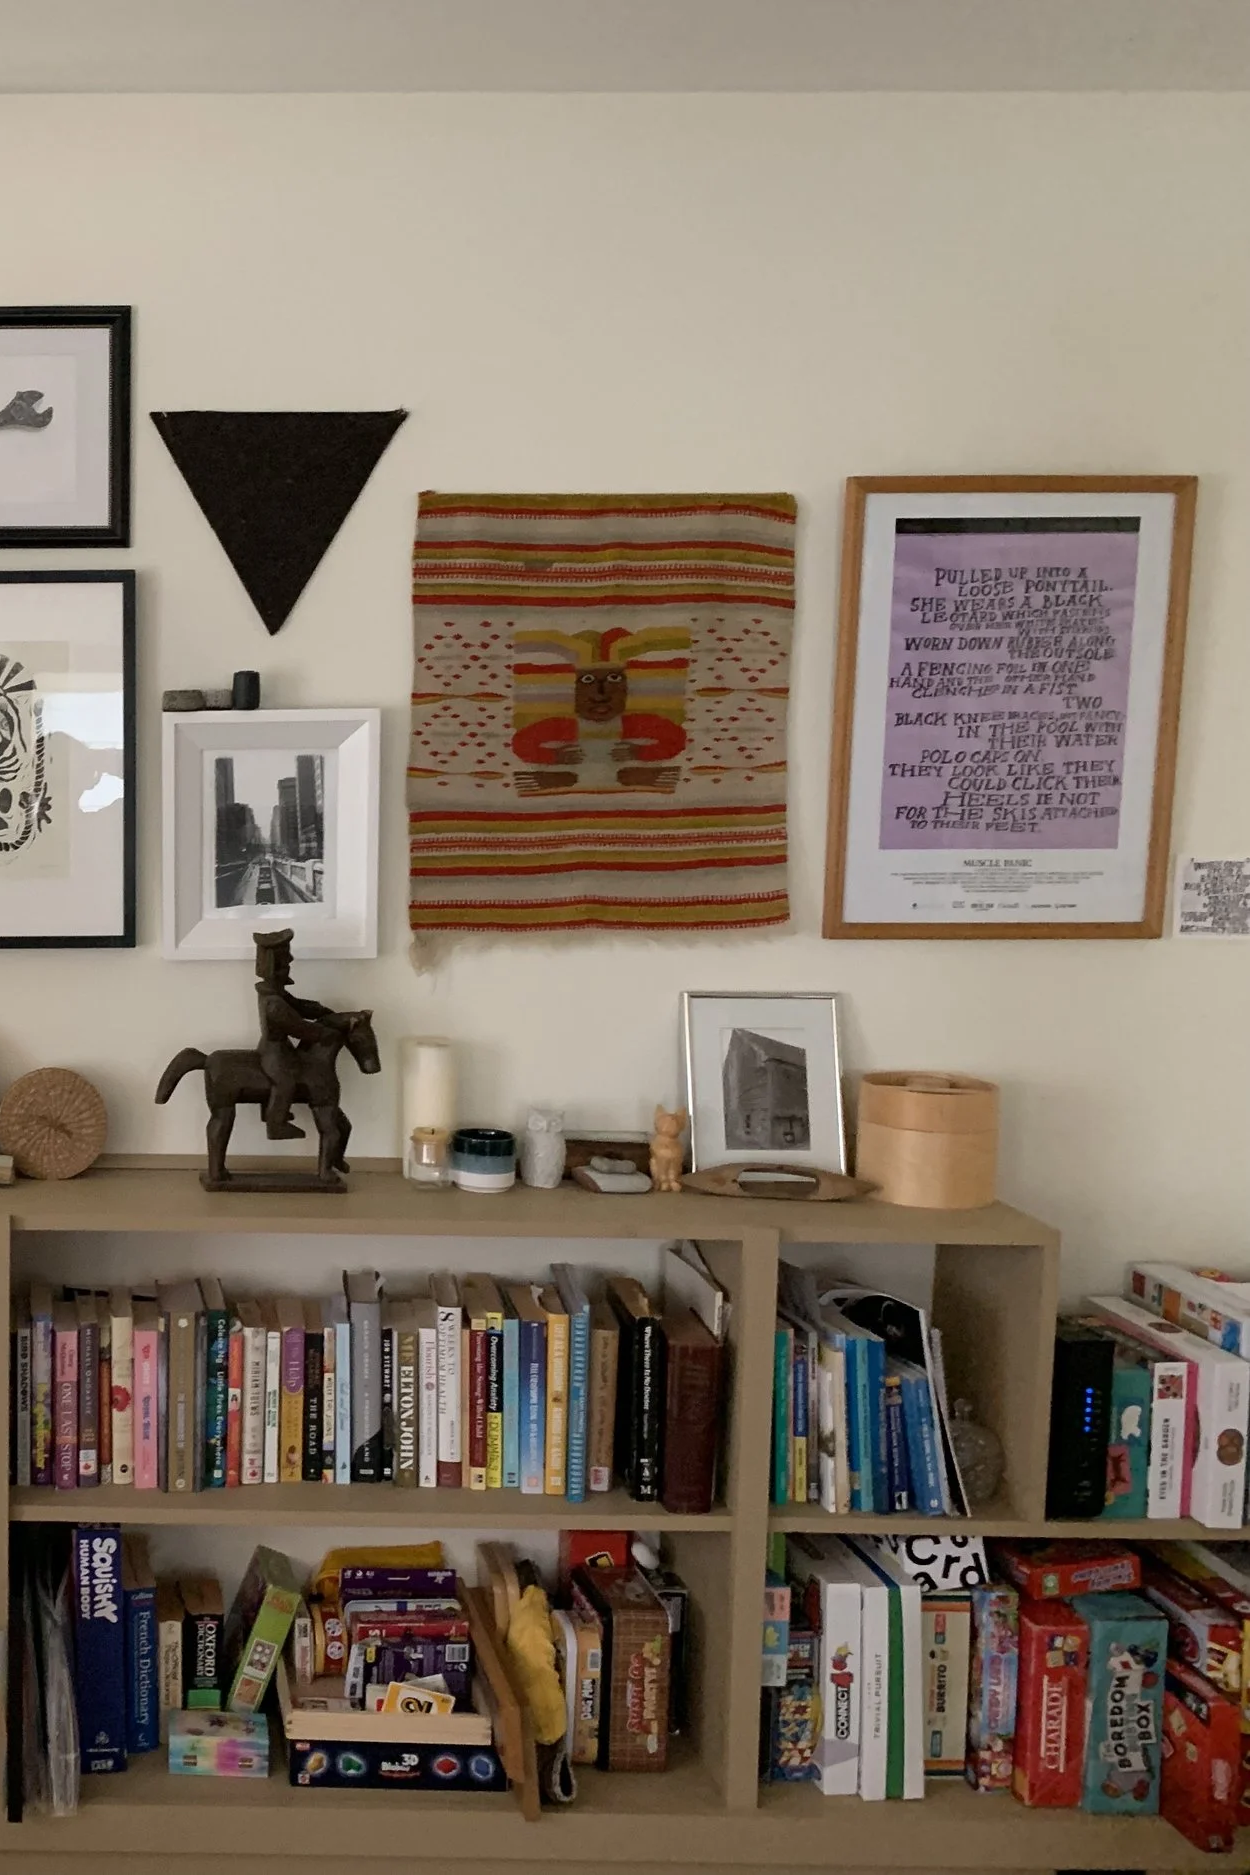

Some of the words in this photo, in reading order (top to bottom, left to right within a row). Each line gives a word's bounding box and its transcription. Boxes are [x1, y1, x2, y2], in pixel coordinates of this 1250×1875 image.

[935, 567, 1004, 587] PULLED
[1008, 567, 1028, 581] UP
[1036, 567, 1071, 579] INTO
[1077, 567, 1088, 579] A
[957, 580, 1014, 598] LOOSE
[1024, 579, 1114, 596] PONYTAIL.
[910, 597, 946, 613] SHE
[954, 596, 1015, 613] WEARS
[1021, 596, 1032, 610] A
[1042, 594, 1102, 610] BLACK
[920, 609, 998, 624] LEOTARD
[1001, 608, 1050, 622] WHICH
[904, 637, 954, 651] WORN
[957, 637, 1003, 650] DOWN
[1069, 635, 1116, 648] ALONG
[1008, 649, 1040, 660] THE
[1042, 648, 1118, 661] OUTSOLE
[900, 662, 913, 677] A
[917, 661, 993, 677] FENCING
[1031, 661, 1047, 674] IN
[1052, 660, 1090, 674] ONE
[889, 675, 935, 690] HAND
[1053, 672, 1096, 683] HAND
[1001, 684, 1019, 695] IN
[1025, 683, 1036, 695] A
[1039, 682, 1078, 697] FIST
[1062, 696, 1103, 710] TWO
[894, 712, 948, 727] BLACK
[953, 711, 1004, 726] KNEE
[957, 725, 980, 739] IN
[989, 722, 1030, 738] THE
[1037, 721, 1078, 735] POOL
[1084, 722, 1124, 734] WITH
[988, 735, 1047, 750] THEIR
[1054, 734, 1119, 748] WATER
[920, 749, 967, 764] POLO
[888, 763, 944, 778] THEY
[952, 764, 999, 777] LOOK
[1006, 763, 1054, 776] LIKE
[1062, 759, 1116, 775] THEY
[947, 776, 1007, 791] COULD
[1011, 776, 1070, 791] CLICK
[1073, 774, 1123, 788] THEIR
[941, 791, 1030, 808] HEELS
[1036, 793, 1053, 806] IF
[1058, 791, 1101, 806] NOT
[894, 806, 928, 820] FOR
[932, 805, 984, 821] THE
[992, 806, 1038, 823] SKIS
[910, 820, 929, 830] TO
[932, 820, 980, 831] THEIR
[963, 859, 1000, 868] MUSCLE
[216, 1318, 225, 1349] Celeste
[439, 1311, 455, 1322] 8
[448, 1362, 455, 1375] TO
[643, 1325, 652, 1349] Where
[20, 1335, 28, 1359] BIRD
[84, 1328, 93, 1366] MICHAEL
[215, 1350, 225, 1364] Ng
[402, 1335, 414, 1362] ME
[488, 1335, 498, 1381] Overcoming
[425, 1341, 436, 1379] Flourish
[475, 1362, 484, 1374] the
[643, 1349, 652, 1369] There
[216, 1371, 224, 1392] Little
[251, 1360, 260, 1389] MIRIAM
[285, 1361, 300, 1388] Help
[643, 1376, 651, 1387] No
[20, 1361, 28, 1412] SHADOWS
[61, 1382, 72, 1405] ONE
[400, 1365, 415, 1420] ELTON
[439, 1374, 447, 1415] HEALTH
[488, 1382, 498, 1411] Anxiety
[215, 1394, 224, 1414] Fires
[250, 1392, 260, 1416] TOEWS
[309, 1397, 317, 1420] THE
[61, 1411, 72, 1441] LAST
[475, 1420, 483, 1439] Child
[214, 1415, 224, 1465] Everywhere
[308, 1424, 317, 1455] ROAD
[399, 1421, 414, 1471] JOHN
[61, 1443, 72, 1471] STOP
[1160, 1452, 1169, 1467] THE
[79, 1539, 90, 1585] HUMAN
[80, 1586, 91, 1621] BODY
[138, 1610, 151, 1655] French
[196, 1623, 205, 1677] DICTIONARY
[205, 1623, 217, 1677] OXFORD
[874, 1653, 882, 1697] PURSUIT
[133, 1658, 151, 1725] Dictionary
[580, 1678, 596, 1699] MAN
[935, 1664, 946, 1713] BURRITO
[580, 1699, 595, 1720] DOG
[835, 1686, 850, 1740] CONNECT
[873, 1699, 882, 1739] TRIVIAL
[1109, 1675, 1132, 1769] BOREDOM
[1136, 1702, 1152, 1742] BOX
[401, 1753, 419, 1766] 3D
